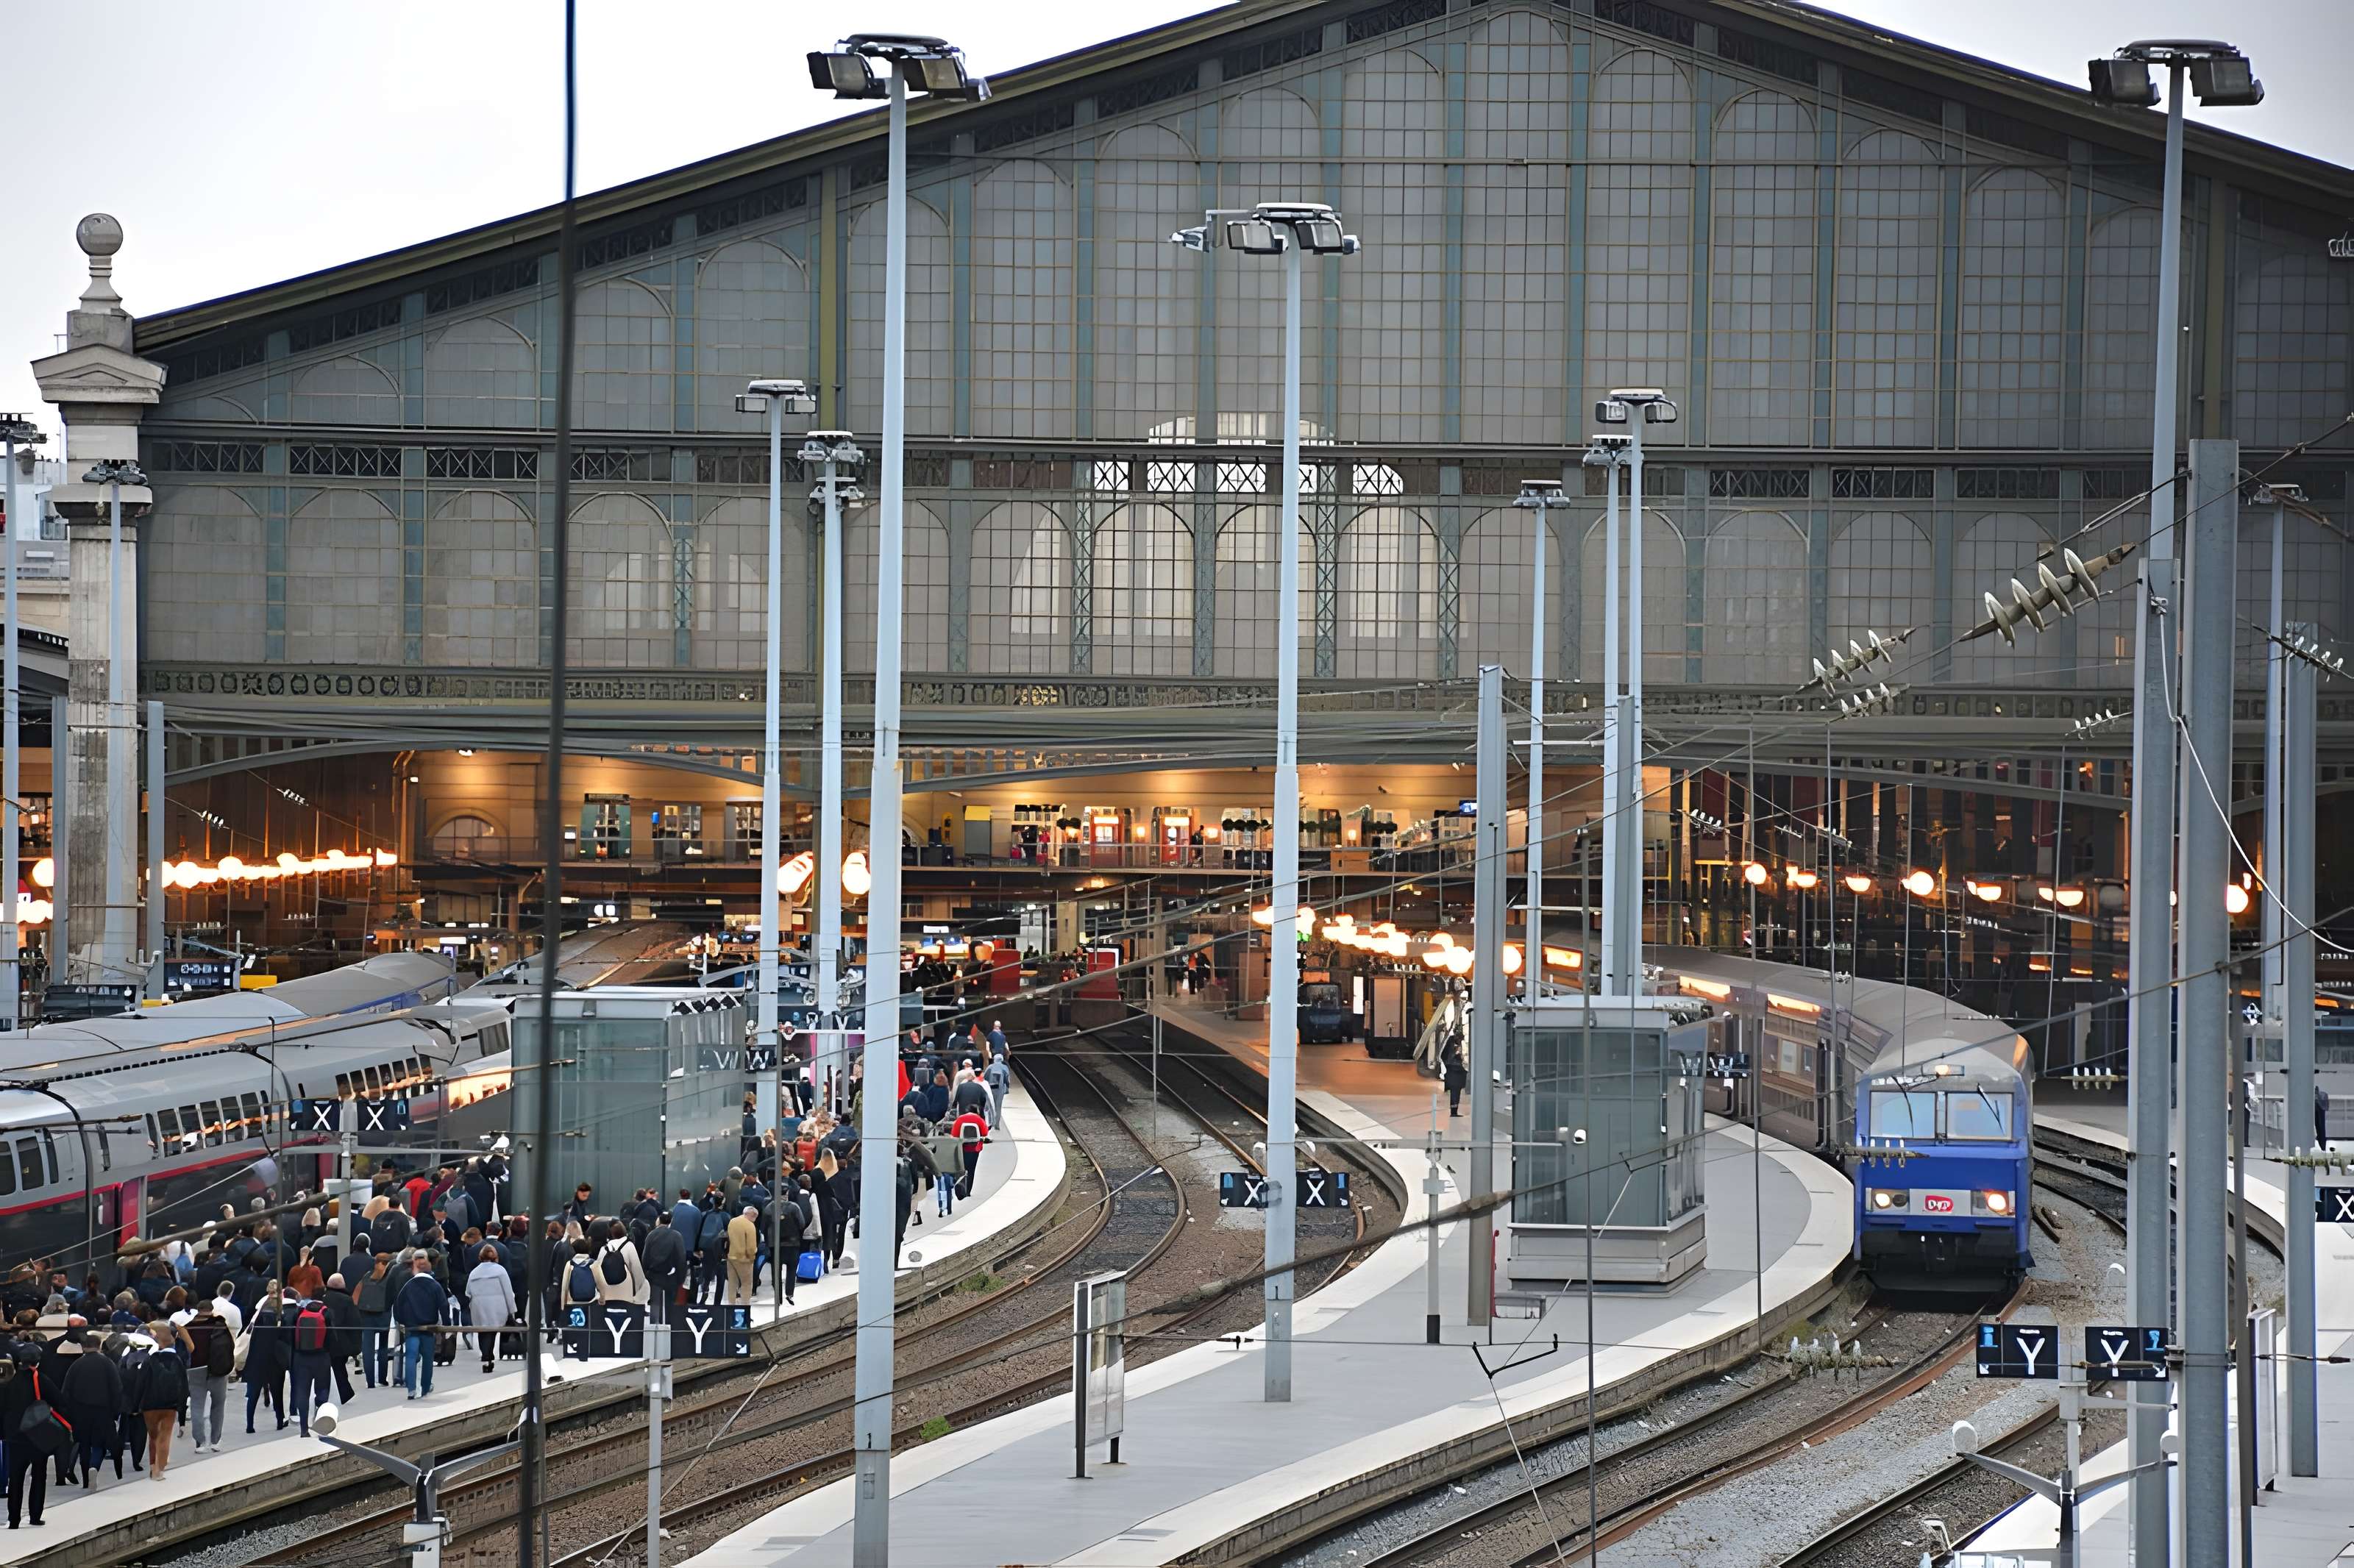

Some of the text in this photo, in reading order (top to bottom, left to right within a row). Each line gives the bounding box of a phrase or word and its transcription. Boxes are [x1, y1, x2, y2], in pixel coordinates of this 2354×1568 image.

[313, 1105, 333, 1130] X
[366, 1105, 385, 1130] X
[1244, 1180, 1263, 1206] X
[1306, 1179, 1326, 1206] X
[2335, 1194, 2354, 1221] X
[604, 1317, 632, 1354] Y
[686, 1317, 713, 1354] Y
[2016, 1337, 2045, 1375] Y
[2100, 1339, 2130, 1377] Y
